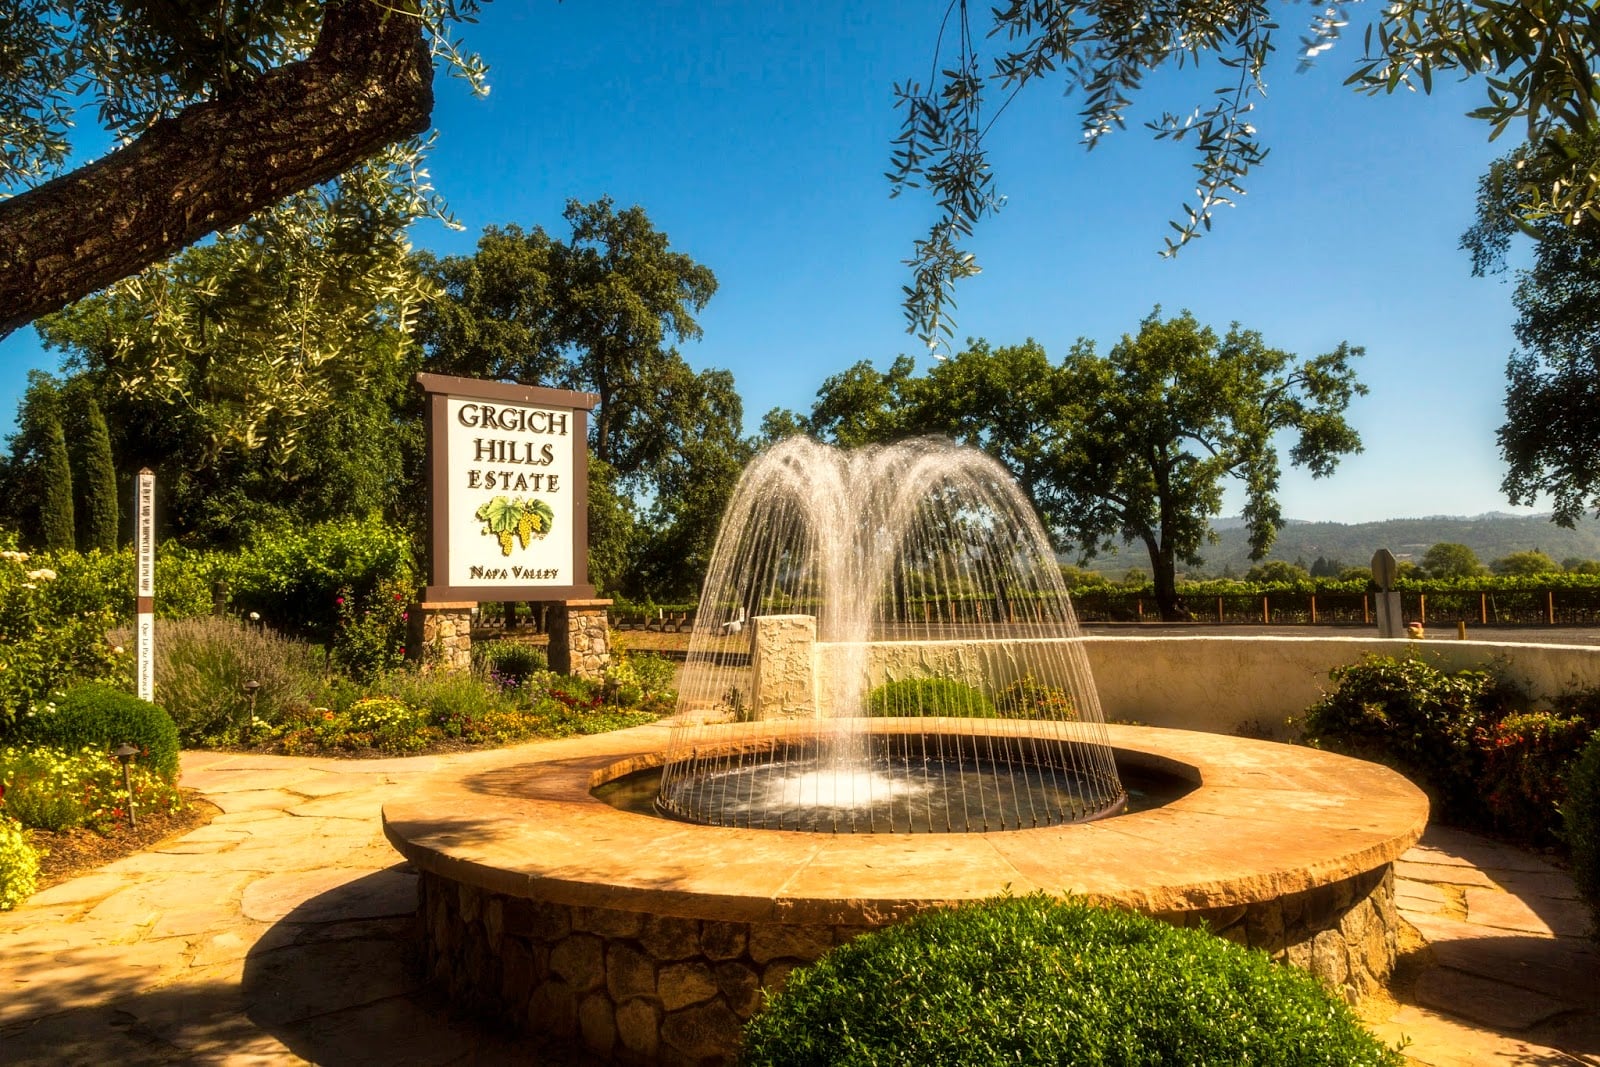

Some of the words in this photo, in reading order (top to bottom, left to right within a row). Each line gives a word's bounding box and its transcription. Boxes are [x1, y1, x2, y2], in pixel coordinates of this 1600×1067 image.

[457, 403, 569, 436] GRGICH
[473, 438, 554, 467] HILLS
[467, 469, 560, 493] ESTATE
[469, 565, 508, 580] NAPA
[512, 565, 559, 580] VALLEY
